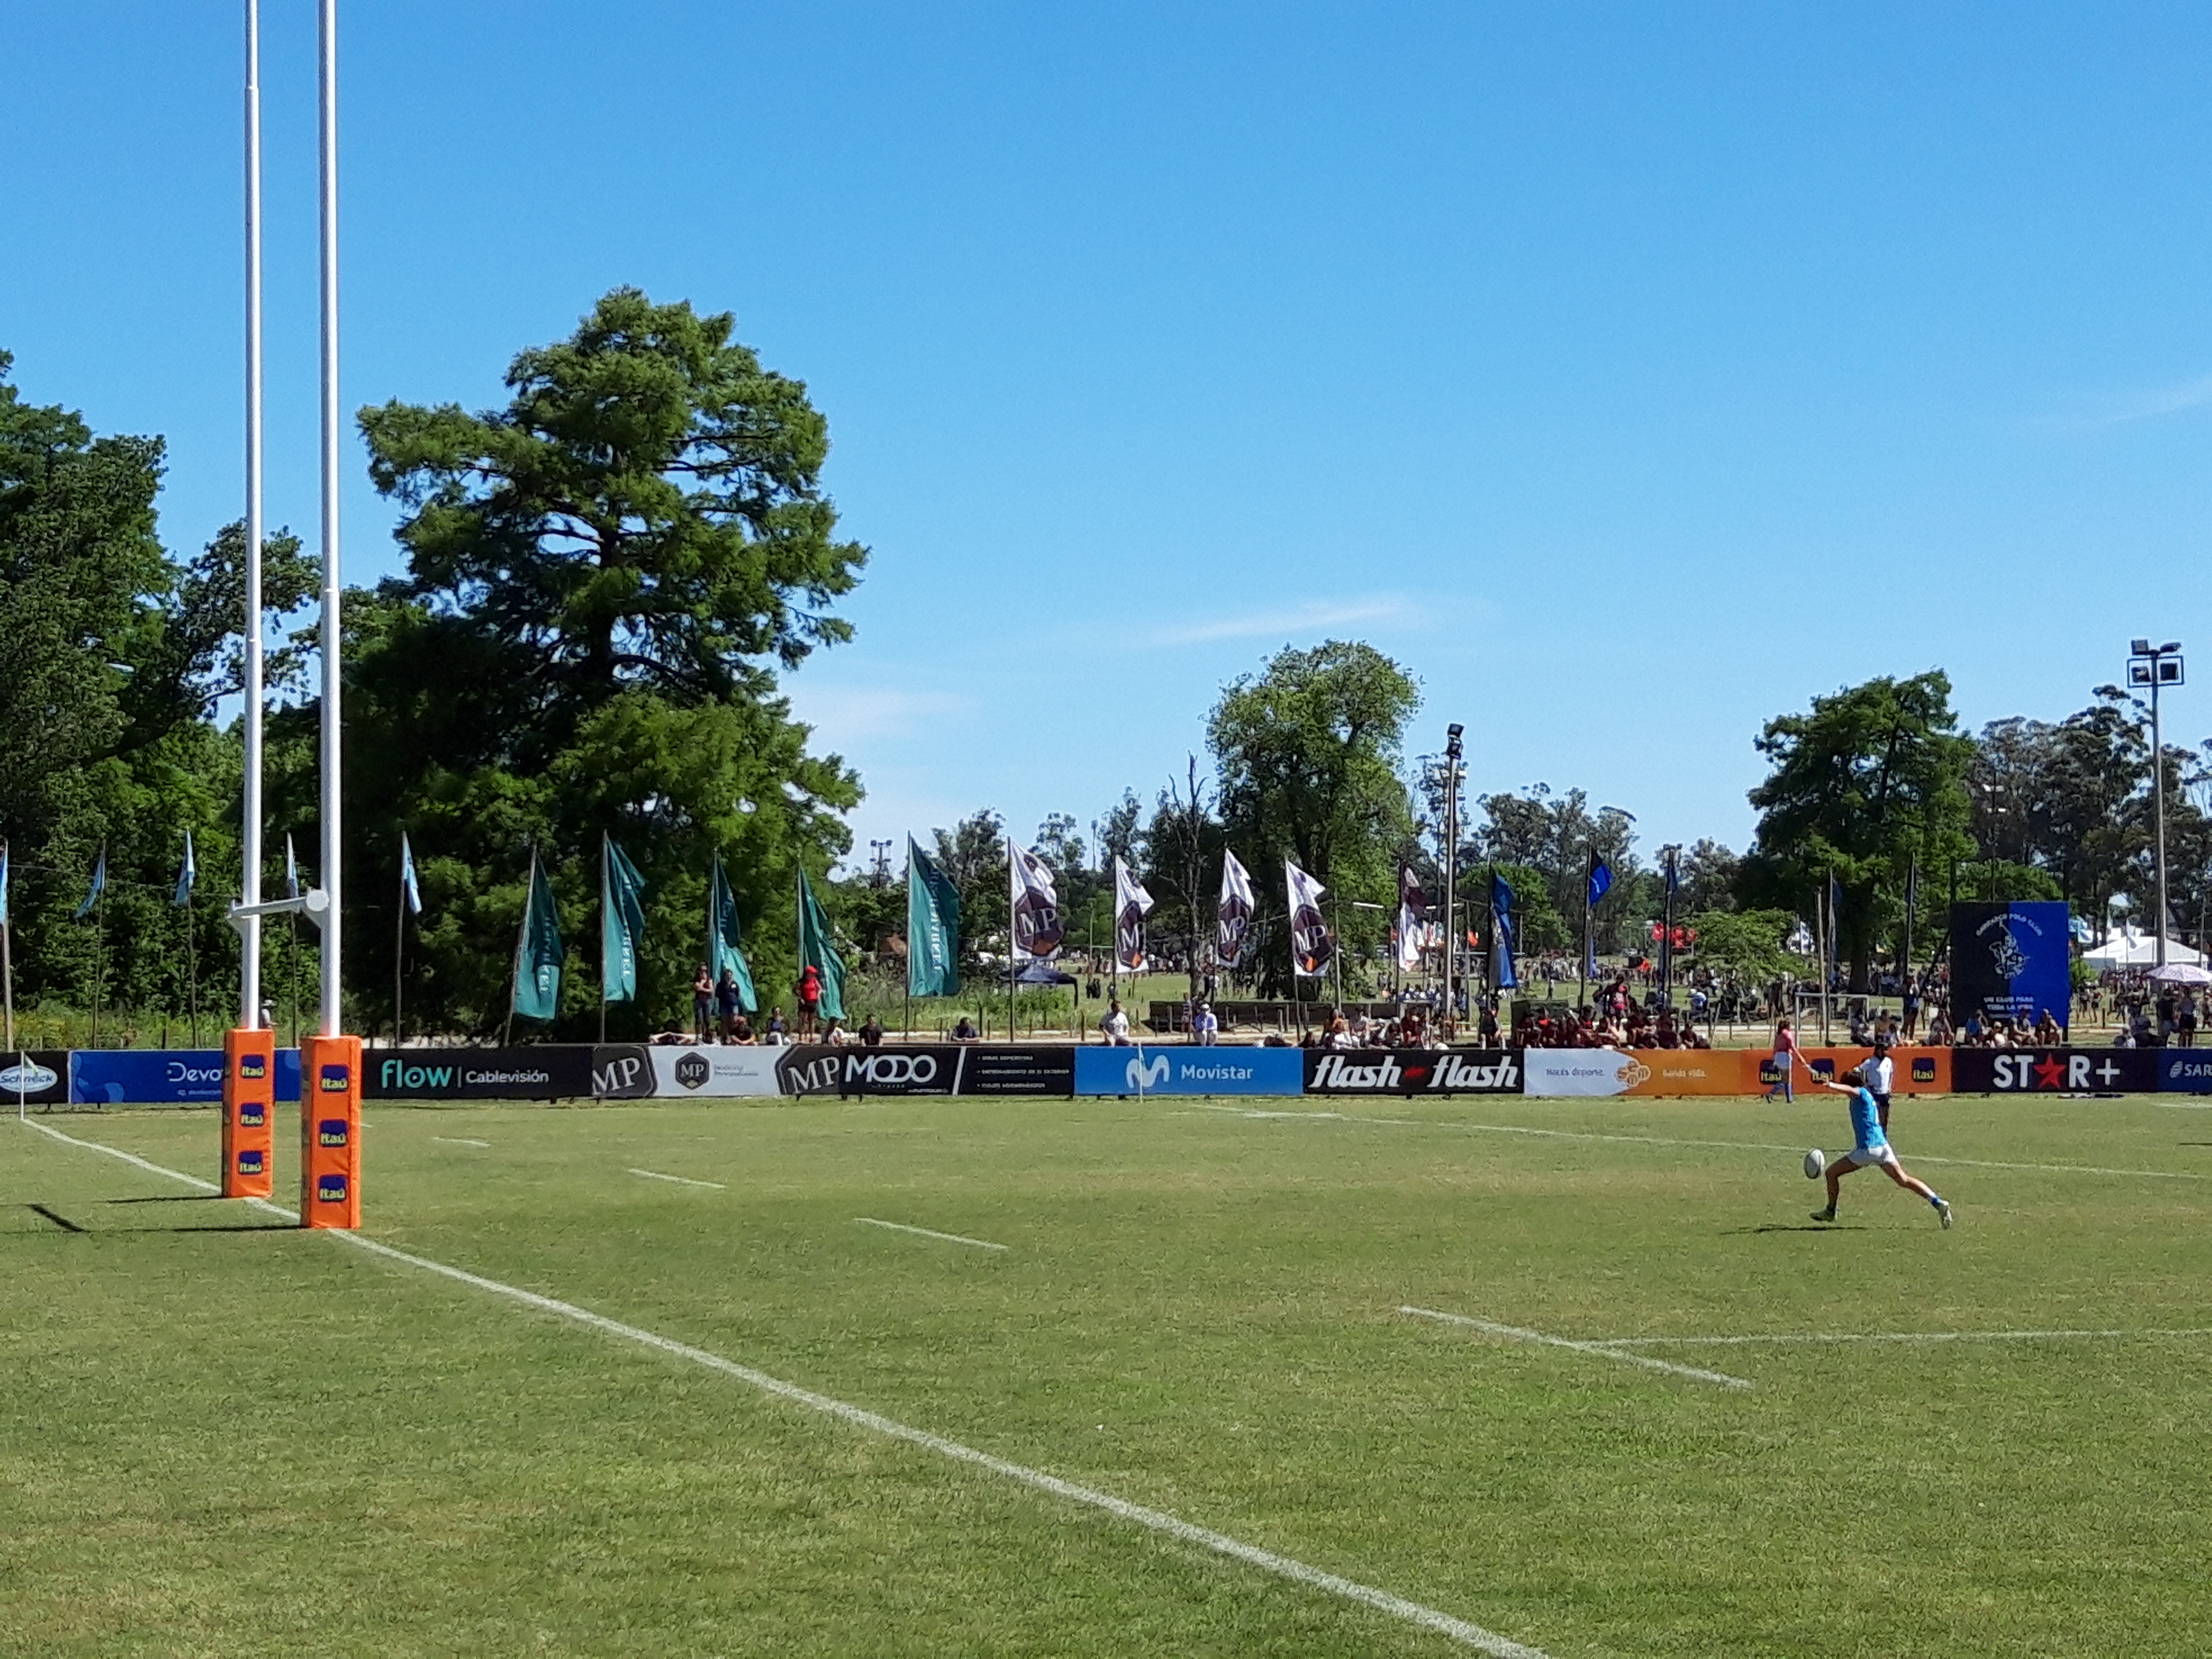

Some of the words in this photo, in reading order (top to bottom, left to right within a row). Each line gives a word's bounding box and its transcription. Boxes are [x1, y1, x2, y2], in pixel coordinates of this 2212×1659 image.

[1219, 916, 1245, 944] MP
[1295, 925, 1326, 952] MP
[167, 1061, 223, 1082] Devo
[382, 1059, 453, 1088] flow
[465, 1070, 549, 1083] Cablevisión
[592, 1057, 640, 1095] MP
[681, 1063, 704, 1077] MP
[787, 1057, 840, 1094] MP
[845, 1055, 937, 1083] MODO
[1181, 1064, 1254, 1079] Movistar
